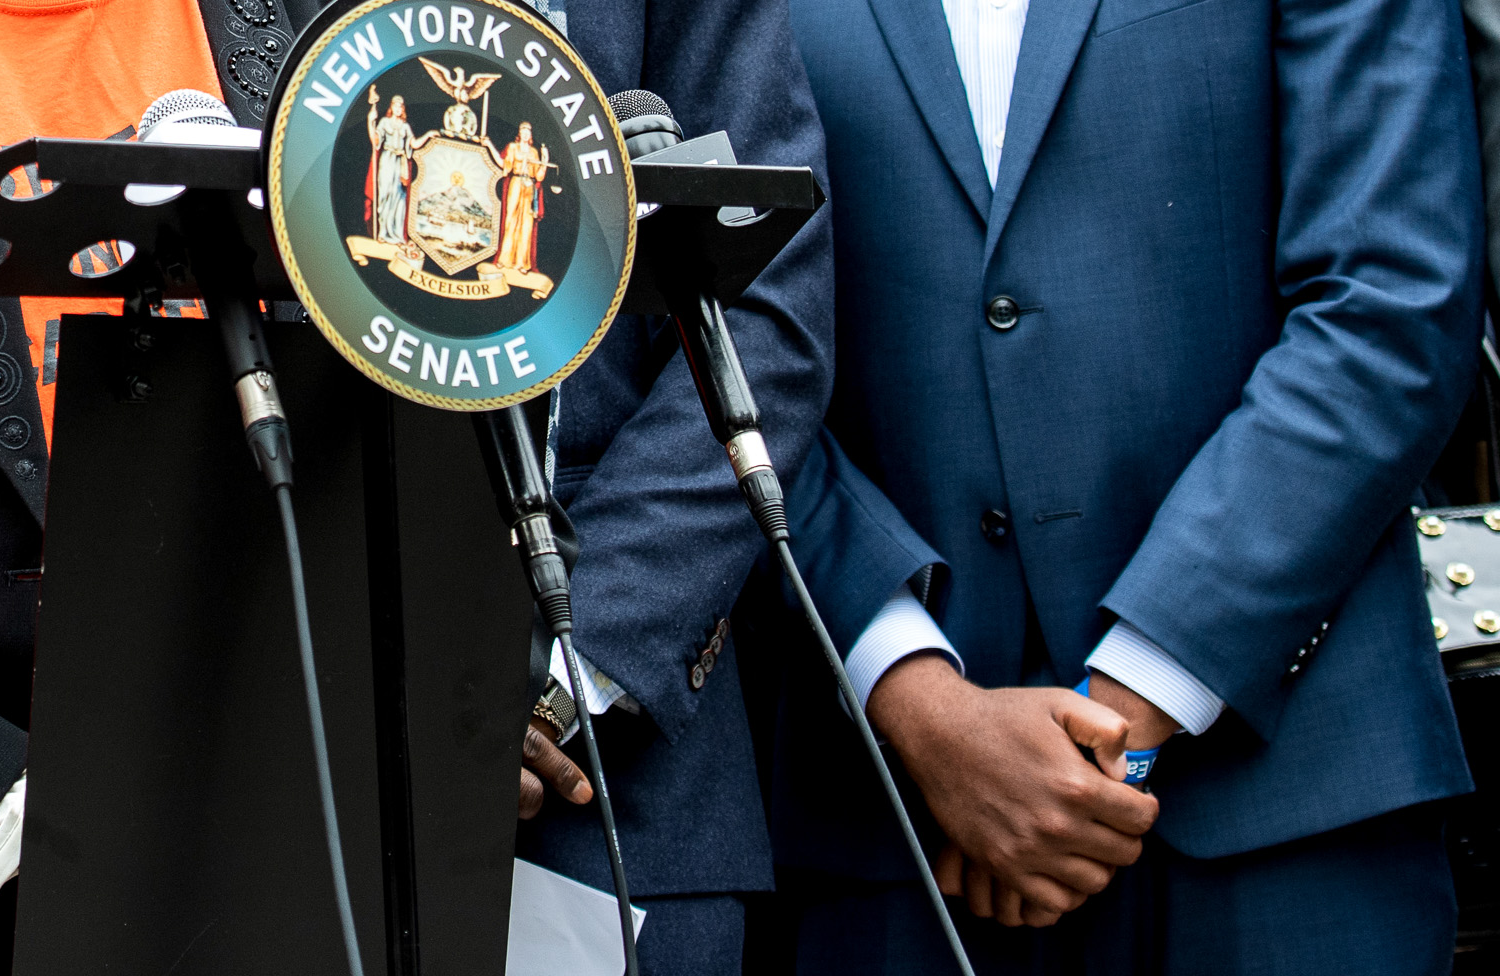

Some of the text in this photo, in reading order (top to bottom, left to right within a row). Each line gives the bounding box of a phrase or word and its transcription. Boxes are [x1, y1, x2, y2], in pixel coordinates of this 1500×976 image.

[302, 4, 614, 181] NEW YORK STATE
[409, 270, 491, 296] EXCELSIOR
[361, 315, 537, 388] SENATE
[566, 645, 577, 668] JAPAN
[576, 681, 585, 701] MADE
